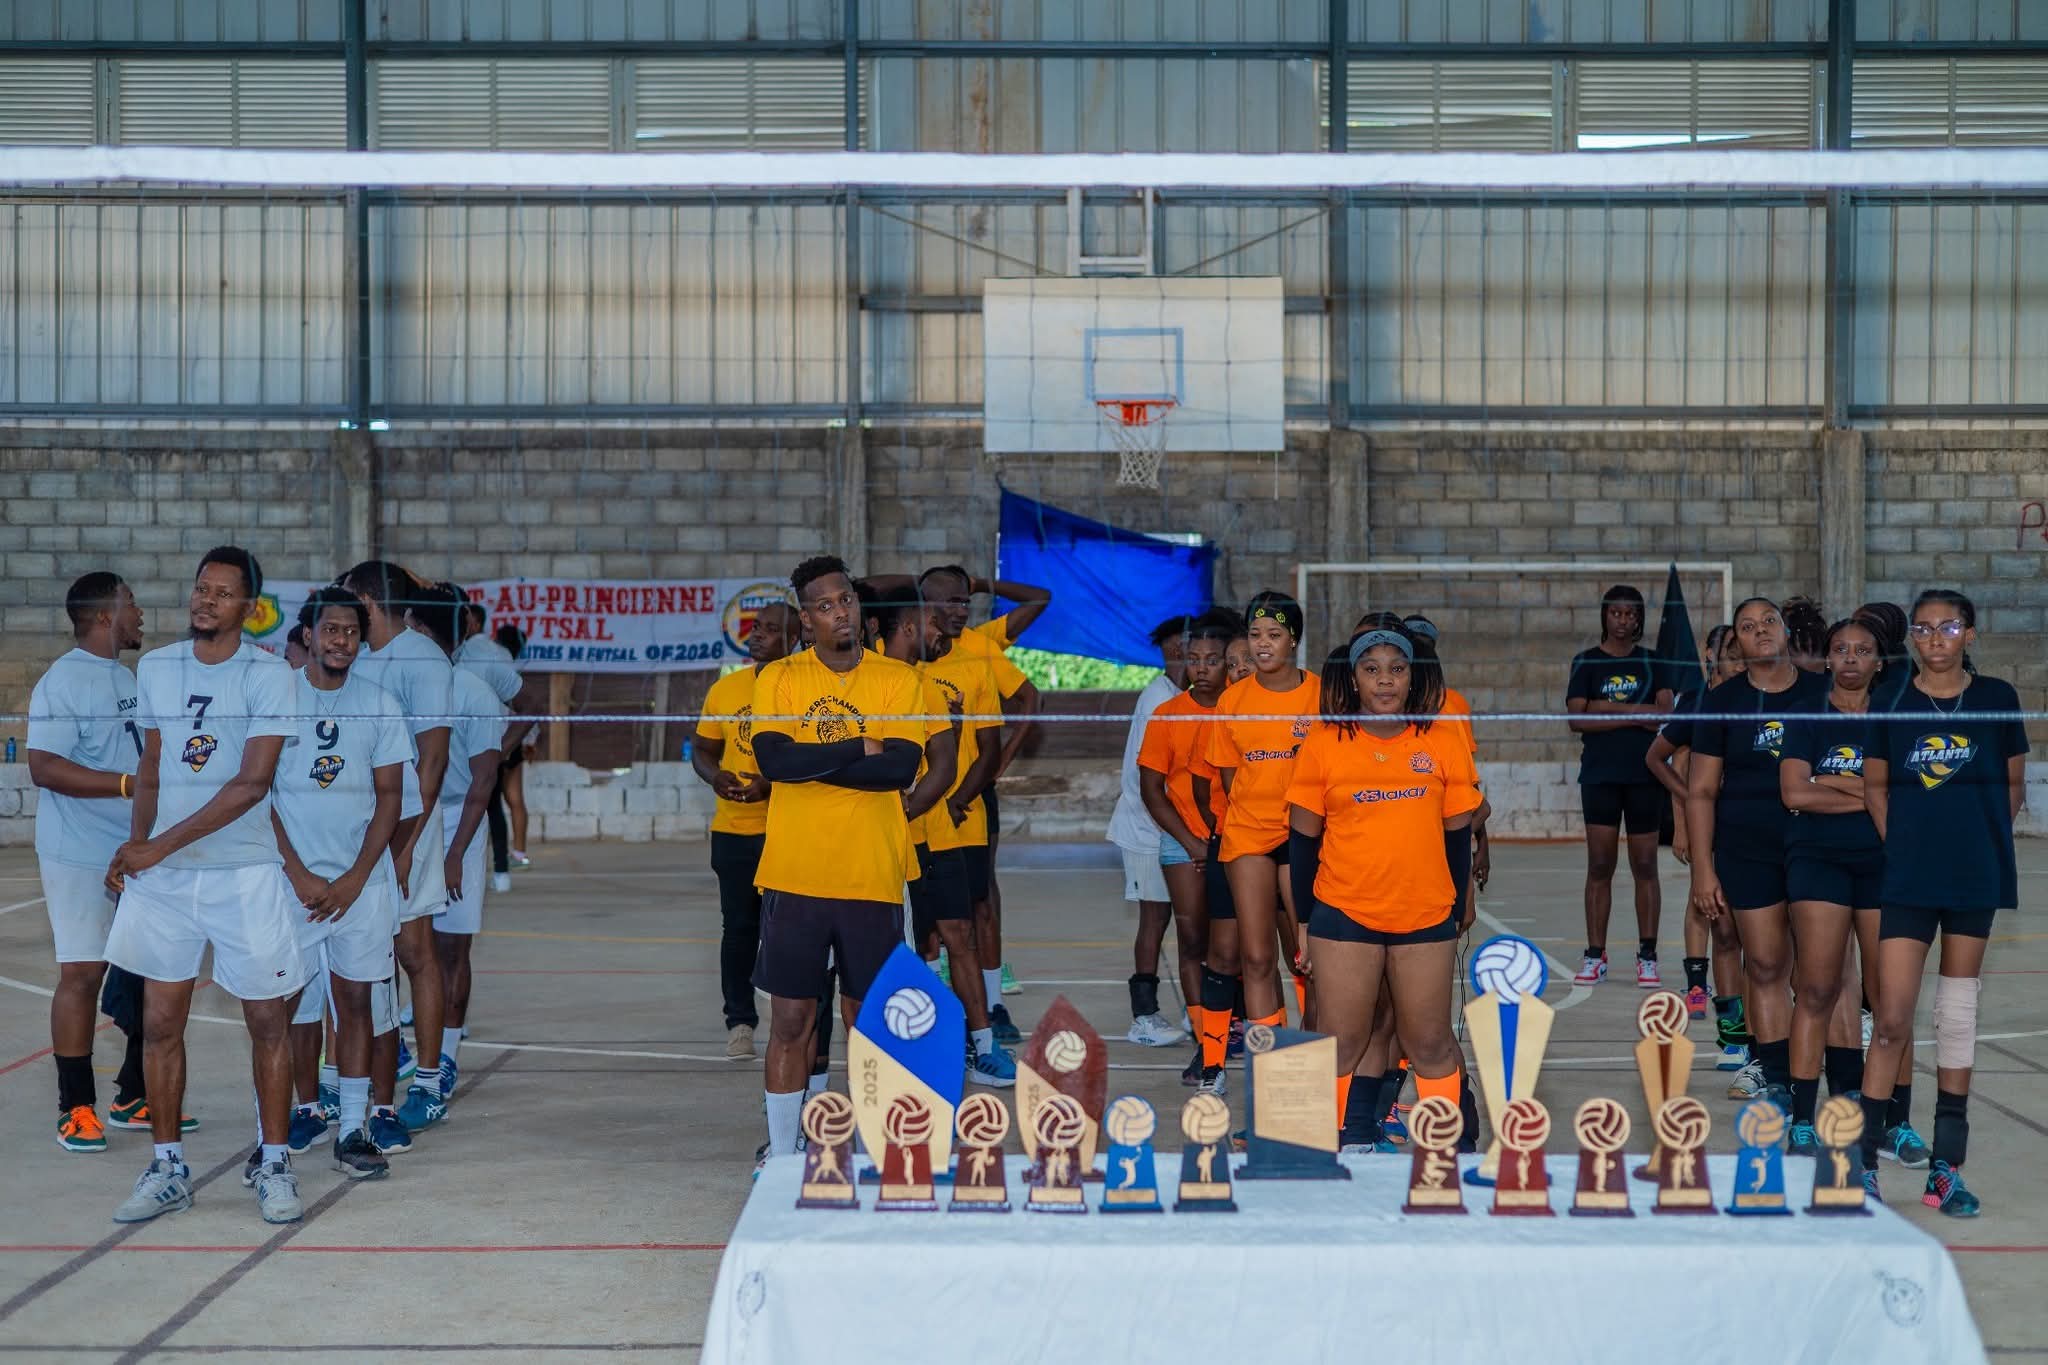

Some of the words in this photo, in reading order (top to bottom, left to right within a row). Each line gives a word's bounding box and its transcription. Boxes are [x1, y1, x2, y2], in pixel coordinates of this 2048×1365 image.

[467, 585, 714, 614] T-AU-PRINCIENNE
[187, 694, 214, 730] 7
[315, 719, 340, 750] 9
[183, 740, 216, 758] ATLANTA
[1910, 747, 1970, 763] ATLANTA
[312, 761, 343, 775] ATLANTA
[1822, 756, 1864, 769] ATLAN
[863, 1057, 878, 1108] 2025
